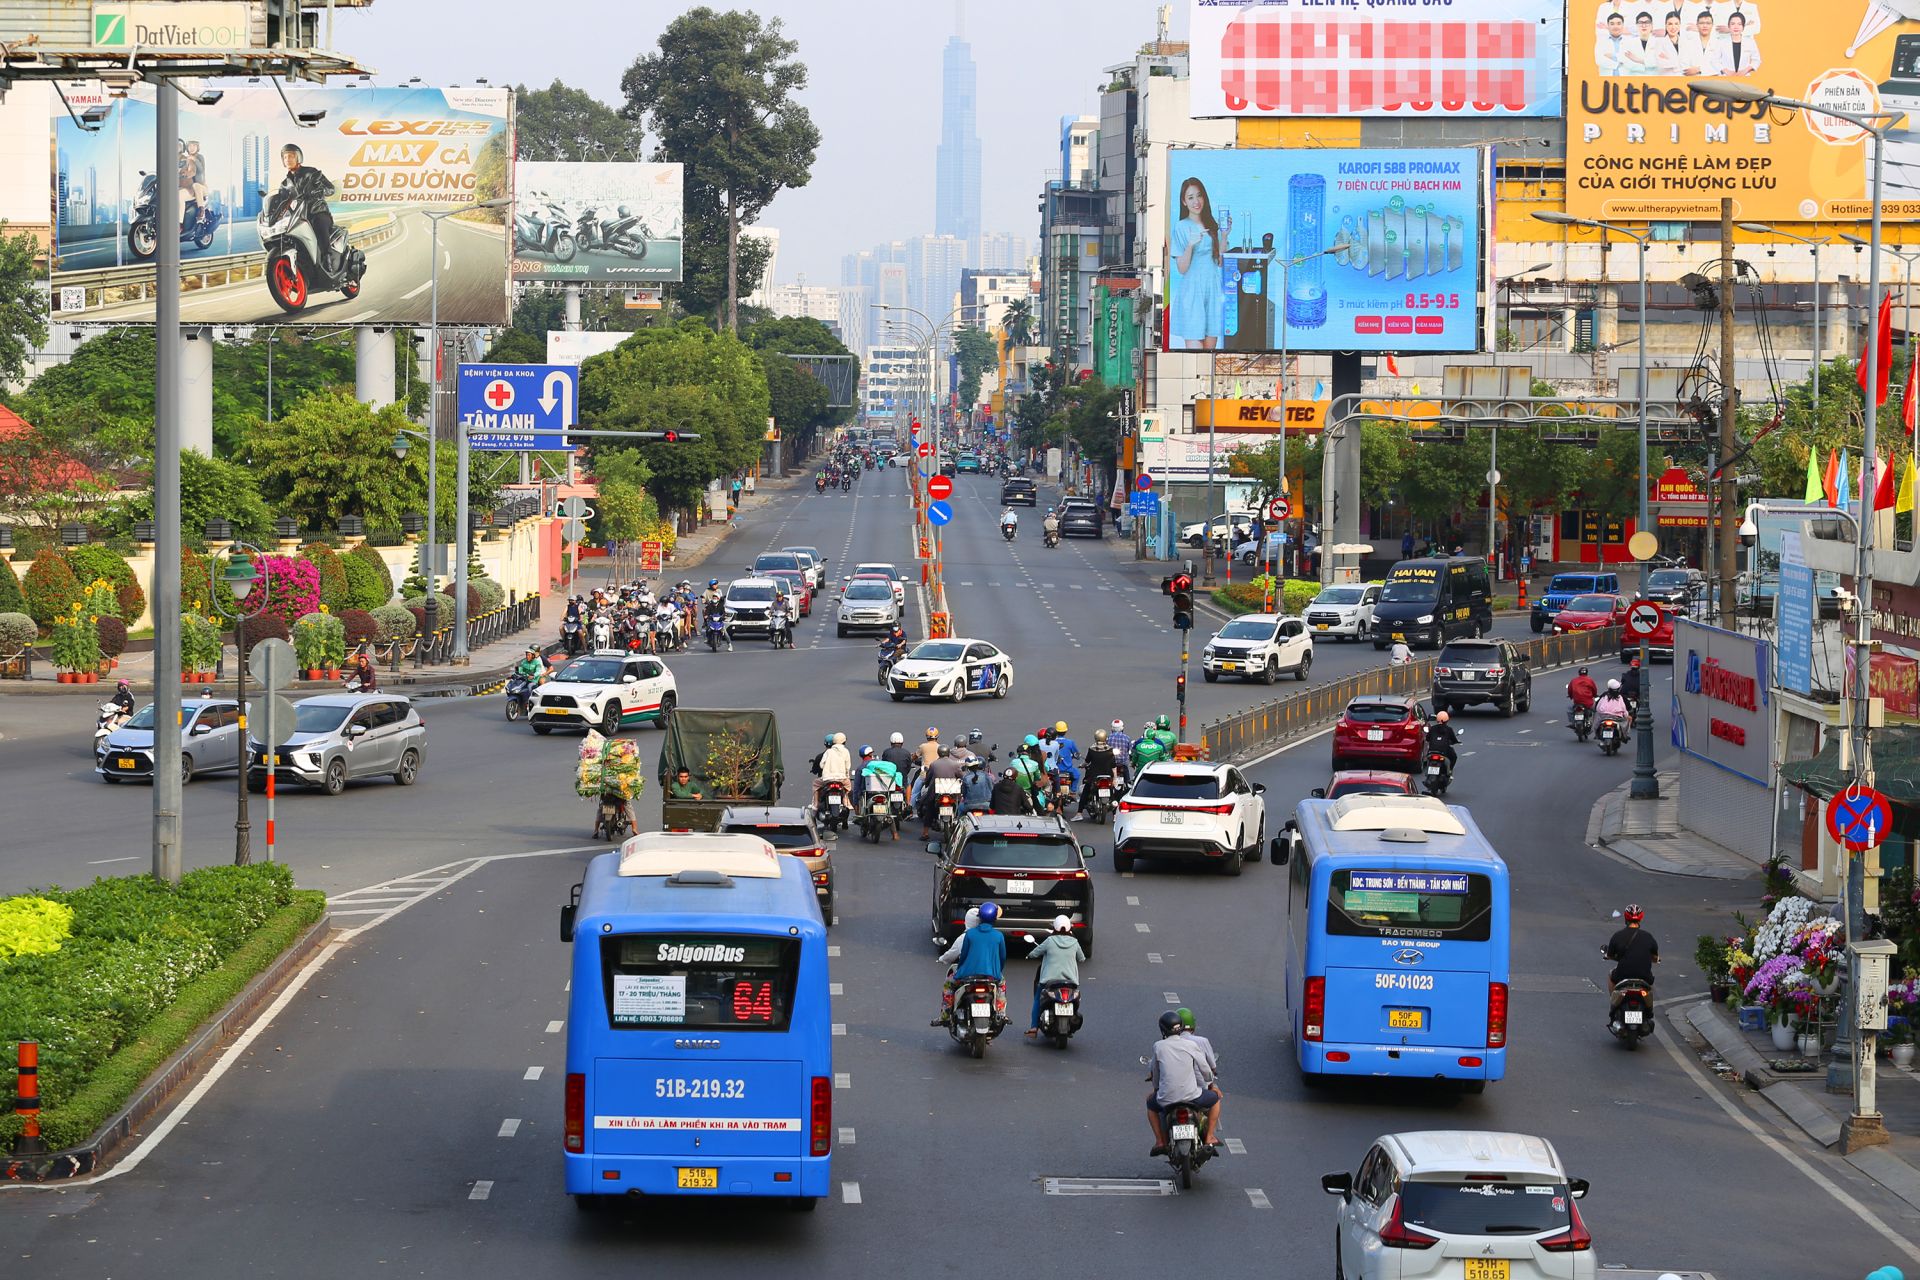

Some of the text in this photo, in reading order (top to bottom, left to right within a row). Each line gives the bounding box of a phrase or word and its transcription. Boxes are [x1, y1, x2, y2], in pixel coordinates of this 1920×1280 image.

[1825, 84, 1861, 97] PHIÊN BẢN
[71, 95, 103, 104] YAMAHA
[1833, 100, 1851, 112] NHẤT
[1852, 100, 1866, 112] CỦA
[1583, 123, 1772, 144] PRIME
[362, 142, 471, 165] MAX CẢ
[1338, 162, 1381, 175] KAROFI
[1408, 162, 1460, 174] PROMAX
[1583, 155, 1772, 173] CÔNG NGHỆ LÀM ĐẸP
[343, 167, 478, 190] ĐÔI ĐƯỜNG
[1578, 172, 1777, 193] CỦA GIỚI THƯỢNG LƯU
[1337, 179, 1462, 193] 7 ĐIỆN CỰC PHỦ BẠCH KIM
[341, 193, 475, 202] BOTH LIVES MAXIMIZED
[1611, 204, 1722, 214] www.ultherapyvietnam.
[1831, 204, 1873, 214] Hotline:
[1880, 204, 1900, 214] 939
[1338, 300, 1344, 309] 3
[1390, 300, 1403, 311] pH
[1405, 293, 1460, 309] 8.5-9.5
[464, 369, 535, 378] BỆNH VIỆN ĐA KHOA
[464, 409, 535, 430] TÂM ANH
[1365, 878, 1383, 888] TRUNG
[1409, 877, 1426, 889] THÀNH
[1378, 928, 1443, 938] TRACOMECO
[1400, 940, 1415, 948] YEN
[657, 943, 745, 964] SaigonBus
[734, 981, 773, 1021] 64
[1398, 1011, 1413, 1019] 50F
[1392, 1019, 1419, 1027] 010.23
[674, 1039, 721, 1050] SAMCO
[655, 1078, 745, 1099] 51B-219.32
[608, 1119, 624, 1128] XIN
[626, 1117, 641, 1128] LỖI
[658, 1118, 678, 1128] LÀM
[709, 1121, 724, 1129] KHI
[727, 1121, 740, 1129] RA
[742, 1119, 760, 1129] VÀO
[763, 1121, 787, 1131] TRẠM
[689, 1168, 707, 1178] 51B
[681, 1178, 714, 1187] 219.32
[1477, 1259, 1498, 1268] 51H
[1469, 1269, 1506, 1279] 518.65
